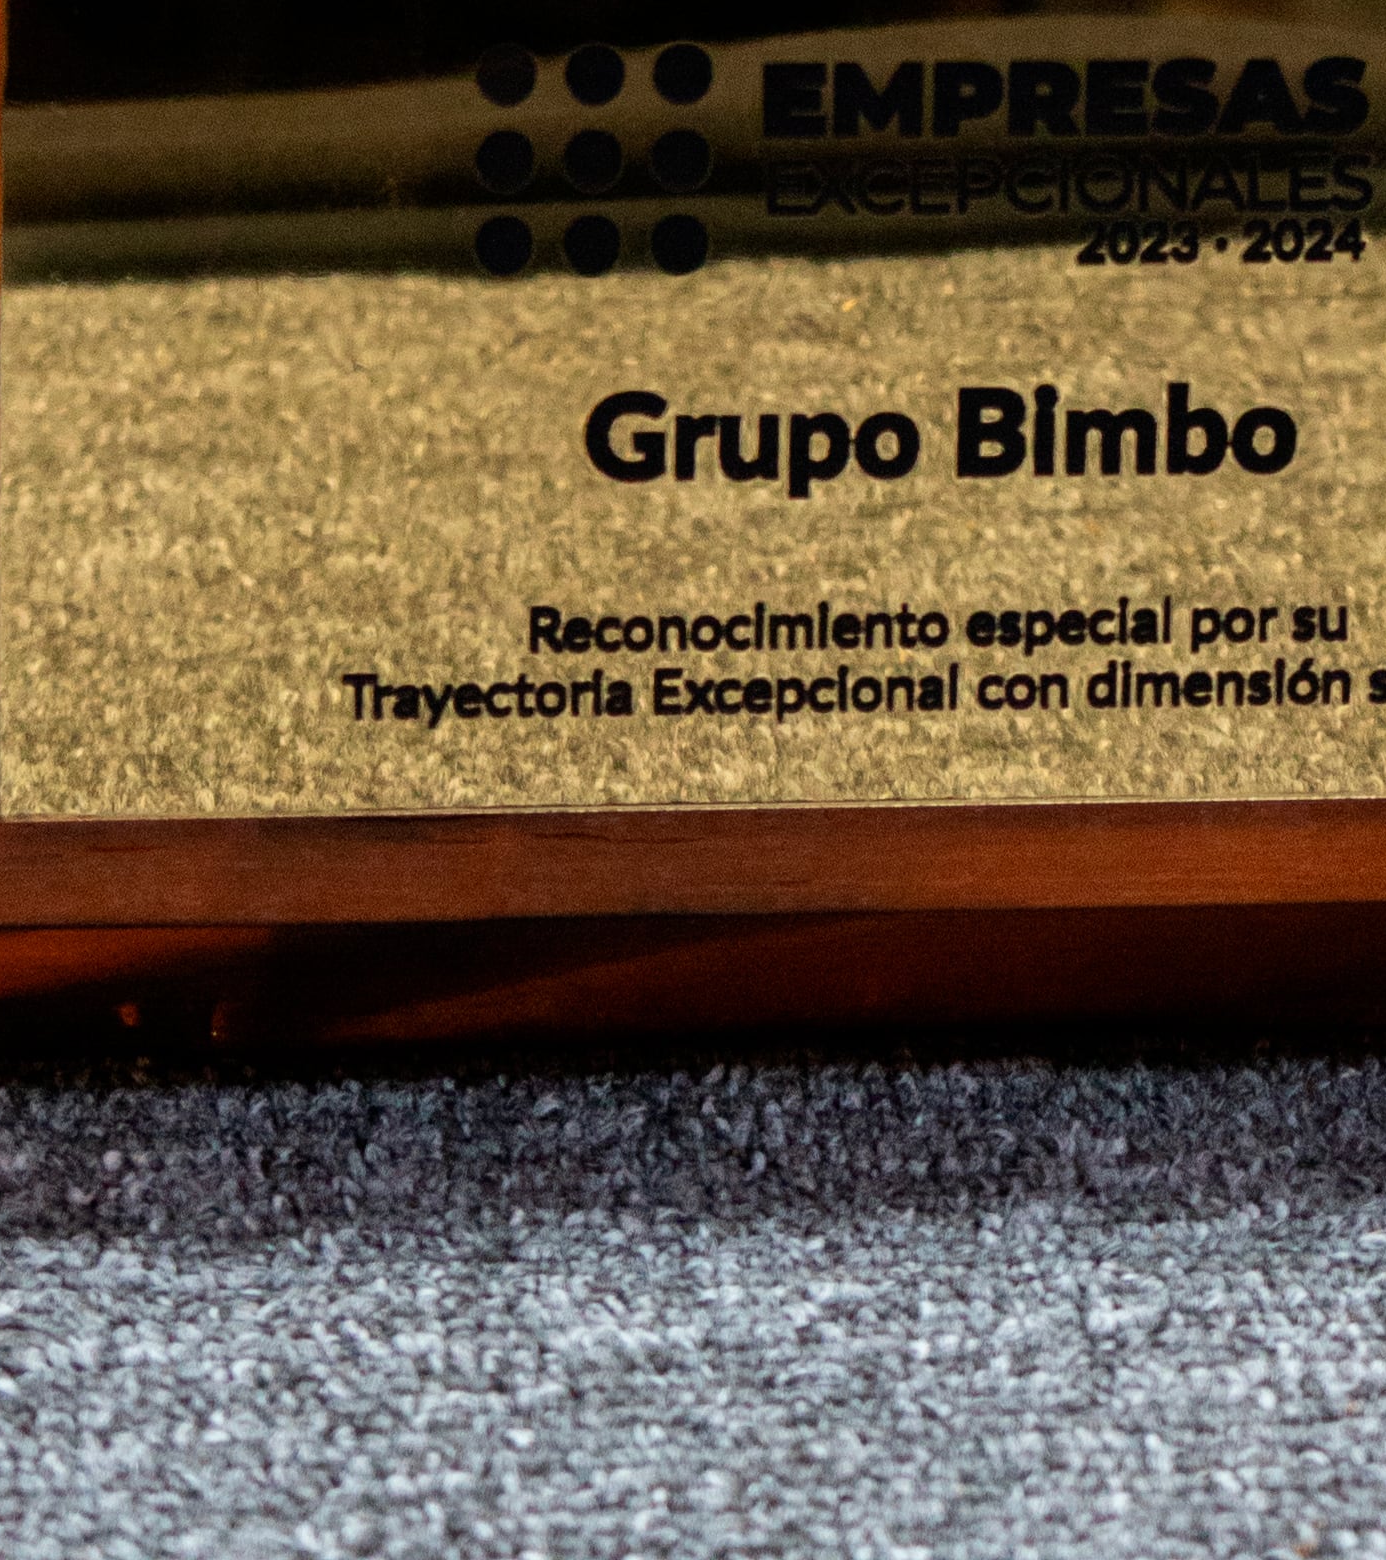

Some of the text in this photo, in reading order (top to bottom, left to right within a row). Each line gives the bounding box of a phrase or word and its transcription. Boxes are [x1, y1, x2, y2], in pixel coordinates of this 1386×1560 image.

[762, 57, 1369, 138] EMPRESAS
[765, 152, 1374, 216] EXCEPCIONALES
[1077, 221, 1200, 265] 2023
[1242, 220, 1366, 263] 2024
[585, 382, 1298, 499] Grupo Bimbo
[529, 595, 1349, 656] Reconocimiento especial por su
[342, 668, 633, 728] Trayectoria
[653, 663, 958, 721] Excepcional
[977, 672, 1069, 710] con
[1086, 657, 1352, 708] dimensión
